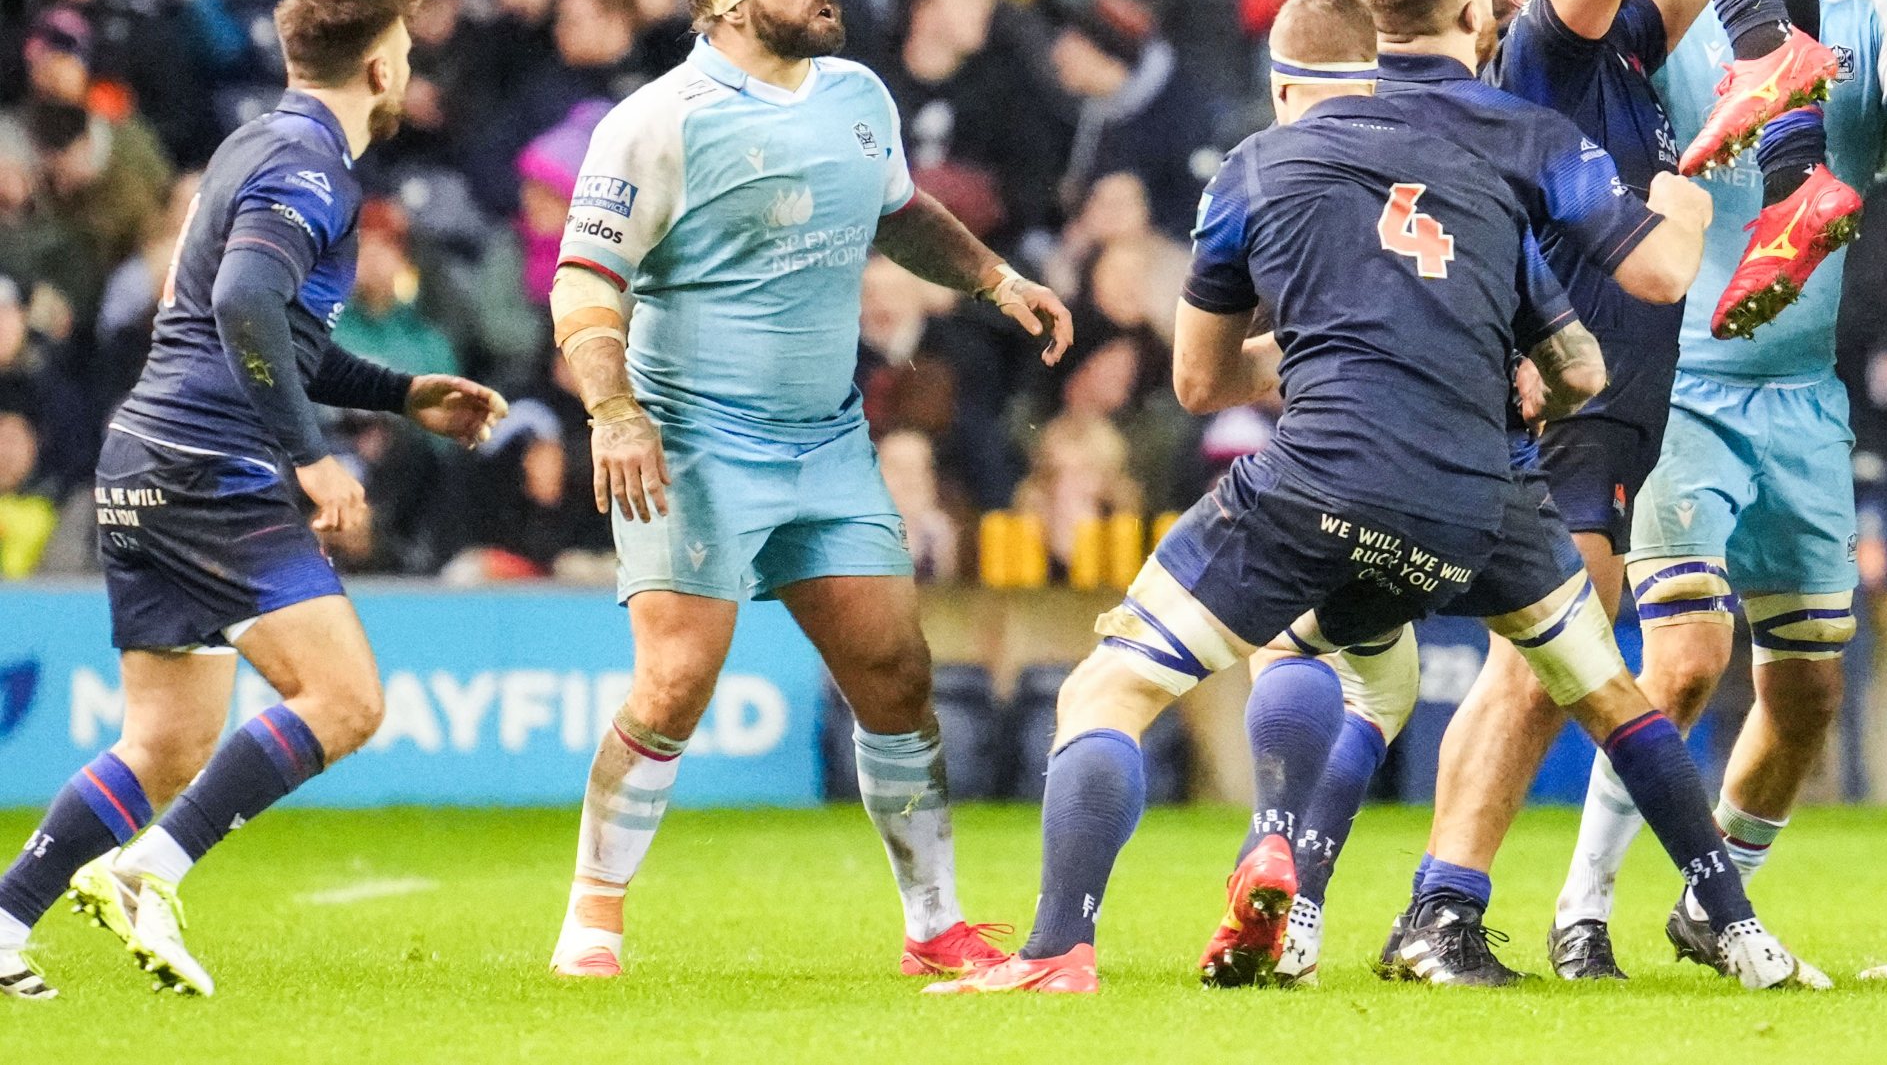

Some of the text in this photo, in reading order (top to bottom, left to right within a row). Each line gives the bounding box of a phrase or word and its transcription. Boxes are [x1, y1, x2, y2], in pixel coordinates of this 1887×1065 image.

[595, 199, 629, 216] SERVICES
[576, 217, 623, 244] leidos
[1377, 183, 1455, 279] 4
[126, 488, 168, 507] WILL
[1320, 513, 1472, 583] WE WILL, WE WILL
[1350, 547, 1439, 593] RUCK YOU
